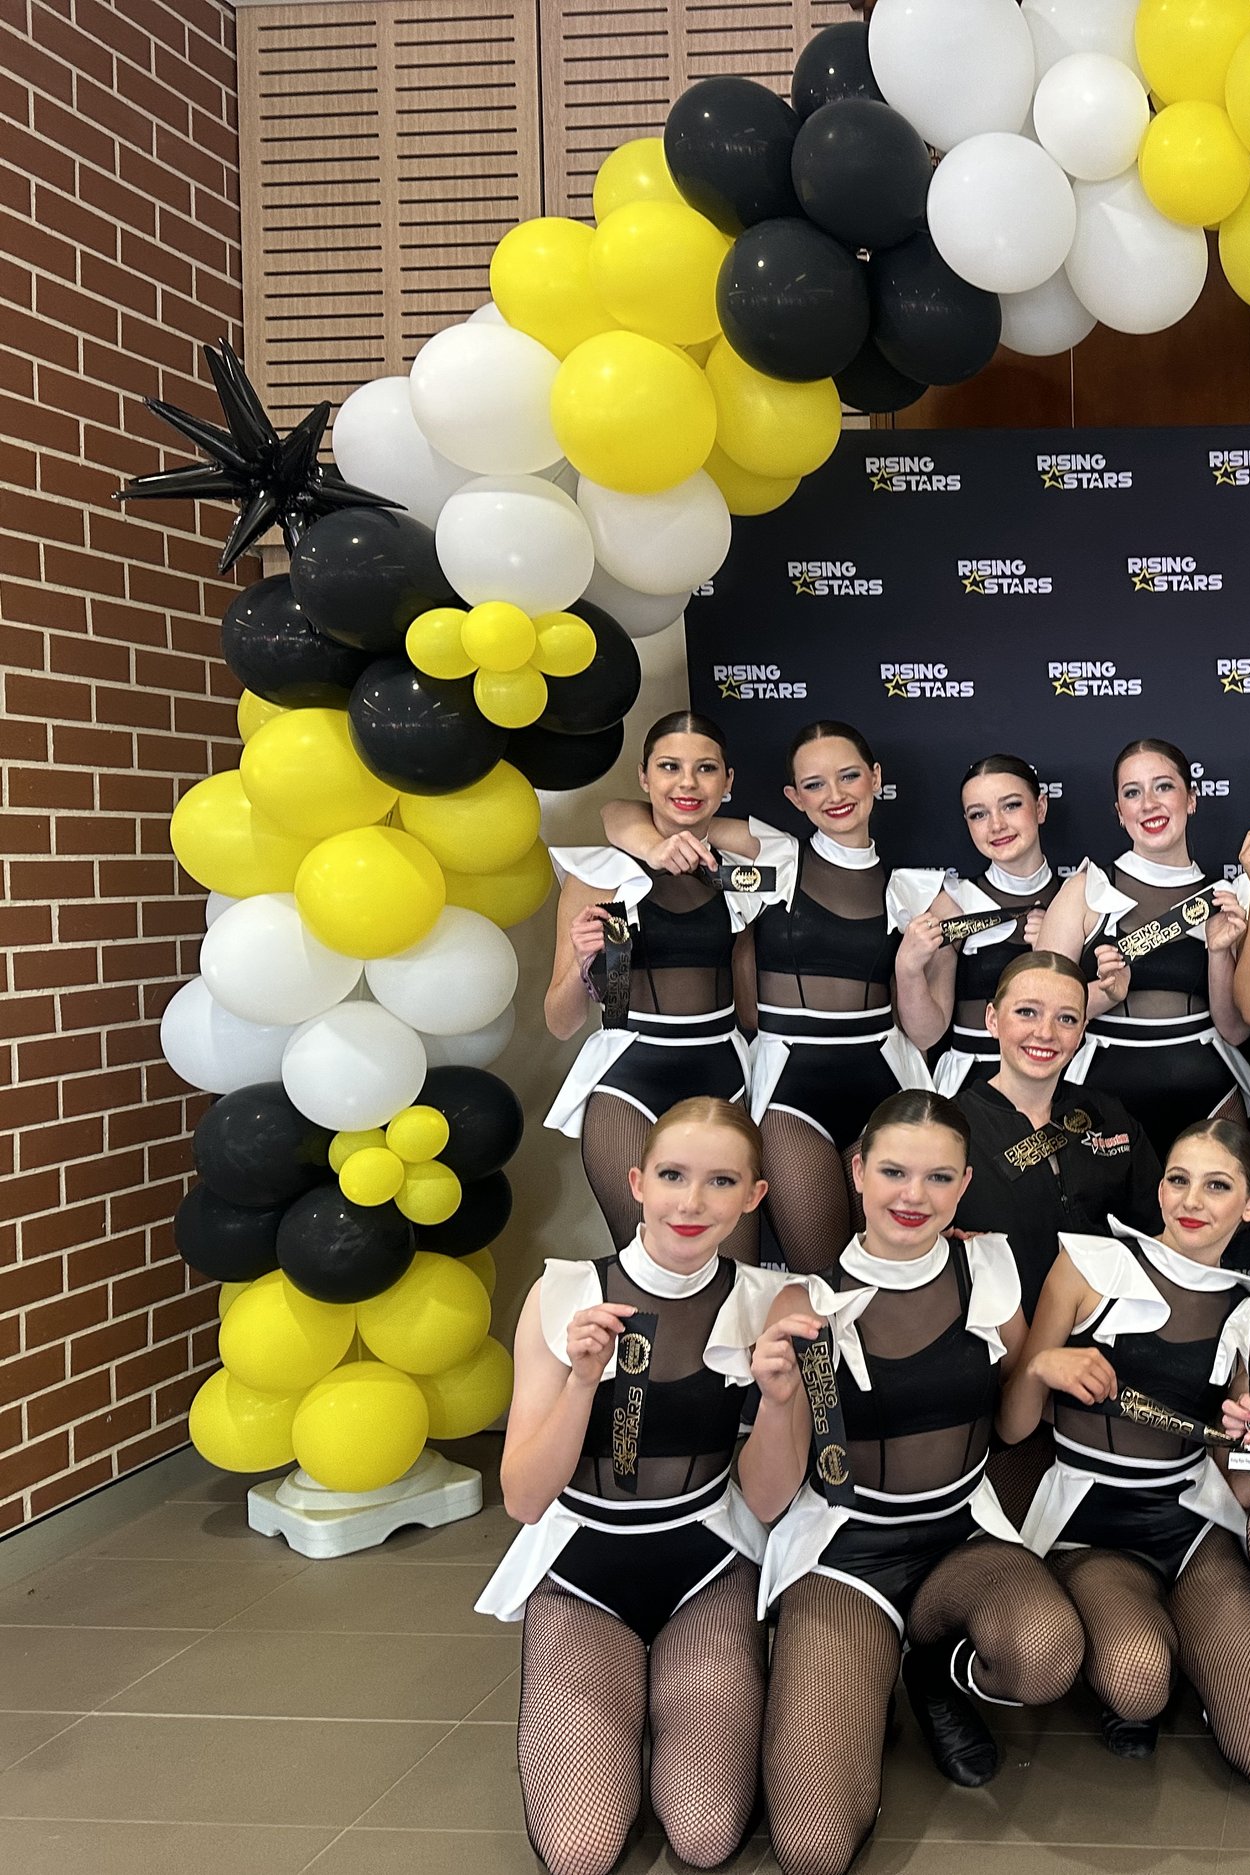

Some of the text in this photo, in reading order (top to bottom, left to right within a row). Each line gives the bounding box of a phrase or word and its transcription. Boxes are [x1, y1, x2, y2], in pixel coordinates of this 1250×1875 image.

[866, 457, 934, 473] RISING
[1037, 454, 1106, 471] RISING
[893, 474, 960, 491] STARS
[1064, 471, 1132, 489] STARS
[788, 562, 856, 577] RISING
[958, 560, 1026, 576] RISING
[1128, 557, 1196, 574] RISING
[815, 578, 882, 595] STARS
[984, 577, 1052, 594] STARS
[1154, 573, 1222, 591] STARS
[714, 665, 780, 681] RISING
[881, 664, 948, 680] RISING
[1049, 662, 1116, 678] RISING
[740, 682, 807, 699] STARS
[907, 681, 974, 697] STARS
[1074, 678, 1142, 696] STARS
[1190, 781, 1229, 796] ARS
[1118, 921, 1161, 953] RISING
[1139, 922, 1181, 956] STARS
[1004, 1130, 1048, 1164] RISING
[1027, 1134, 1068, 1165] STARS
[811, 1341, 837, 1408] RISING
[805, 1370, 829, 1435] STARS
[624, 1386, 643, 1459] STARS
[1138, 1408, 1194, 1436] STARS
[612, 1407, 626, 1476] RISING
